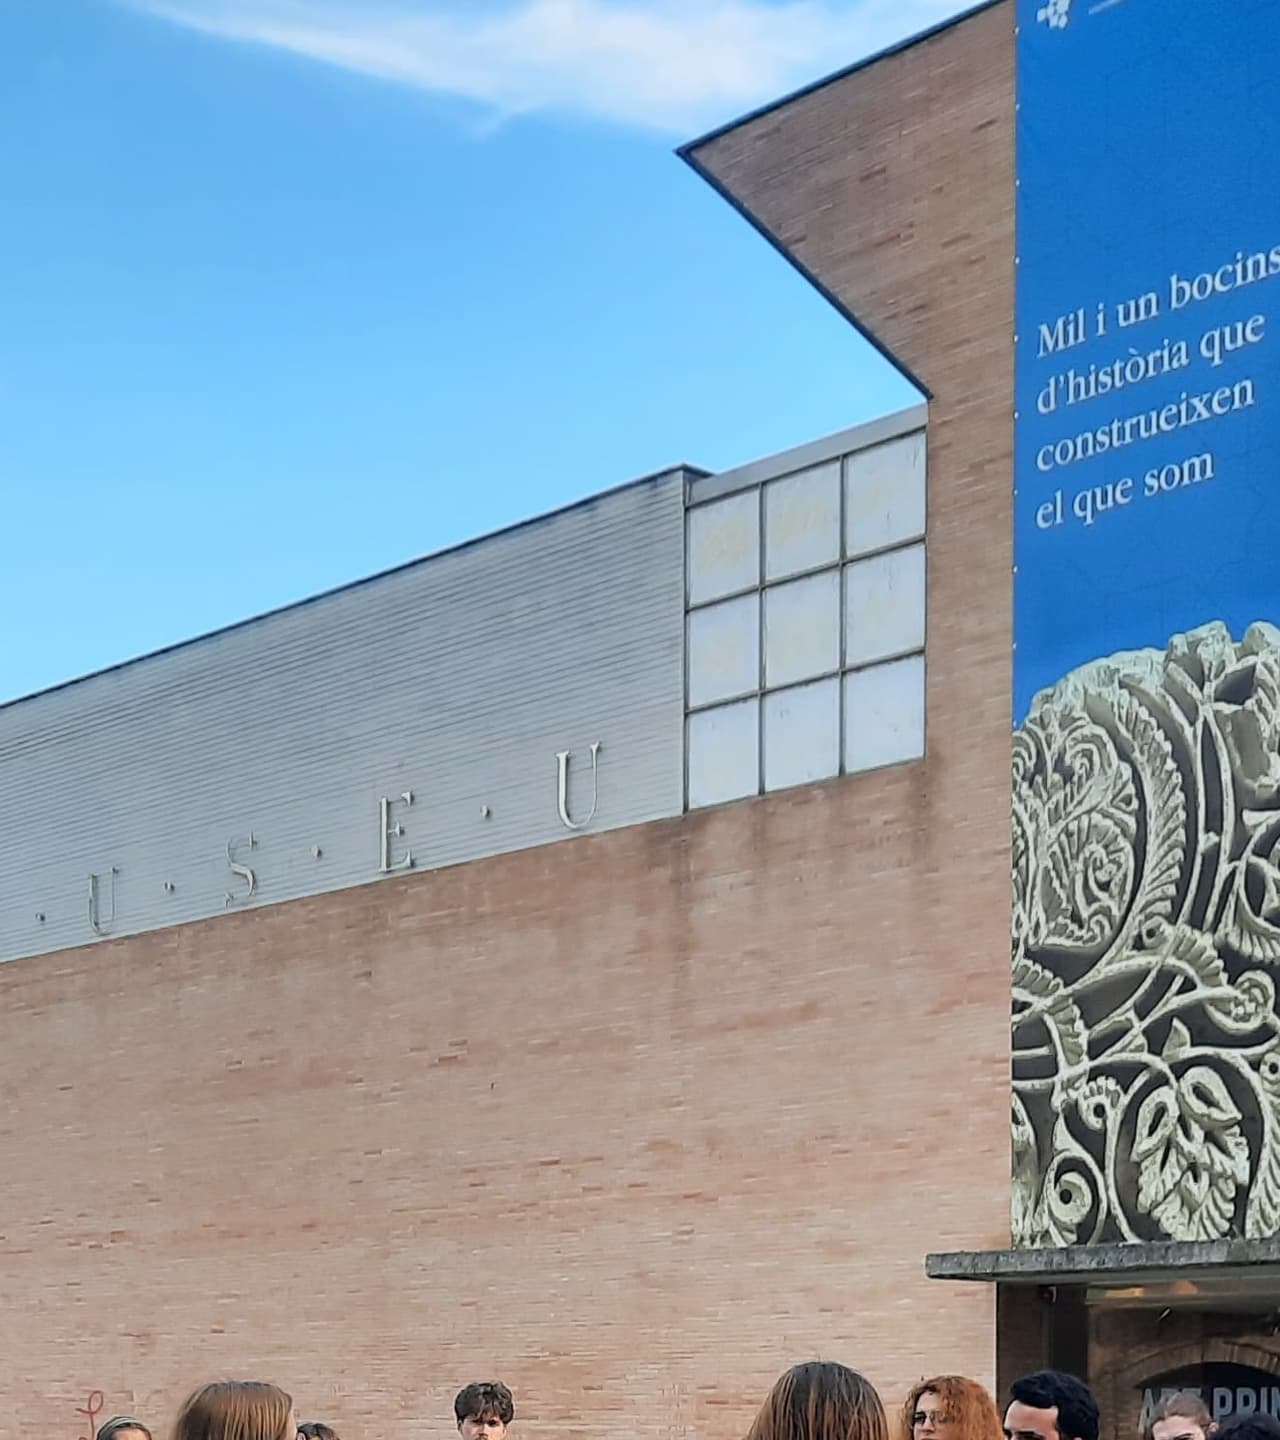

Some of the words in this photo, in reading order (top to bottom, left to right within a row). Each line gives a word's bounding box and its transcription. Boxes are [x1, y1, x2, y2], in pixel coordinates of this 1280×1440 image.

[1037, 307, 1087, 359] Mil
[1095, 301, 1107, 338] i
[1116, 291, 1160, 328] un
[1037, 338, 1190, 415] d'història
[1200, 313, 1266, 368] que
[1036, 378, 1255, 472] construeixen
[1036, 489, 1064, 530] el
[1073, 477, 1134, 527] que
[1143, 452, 1215, 498] som
